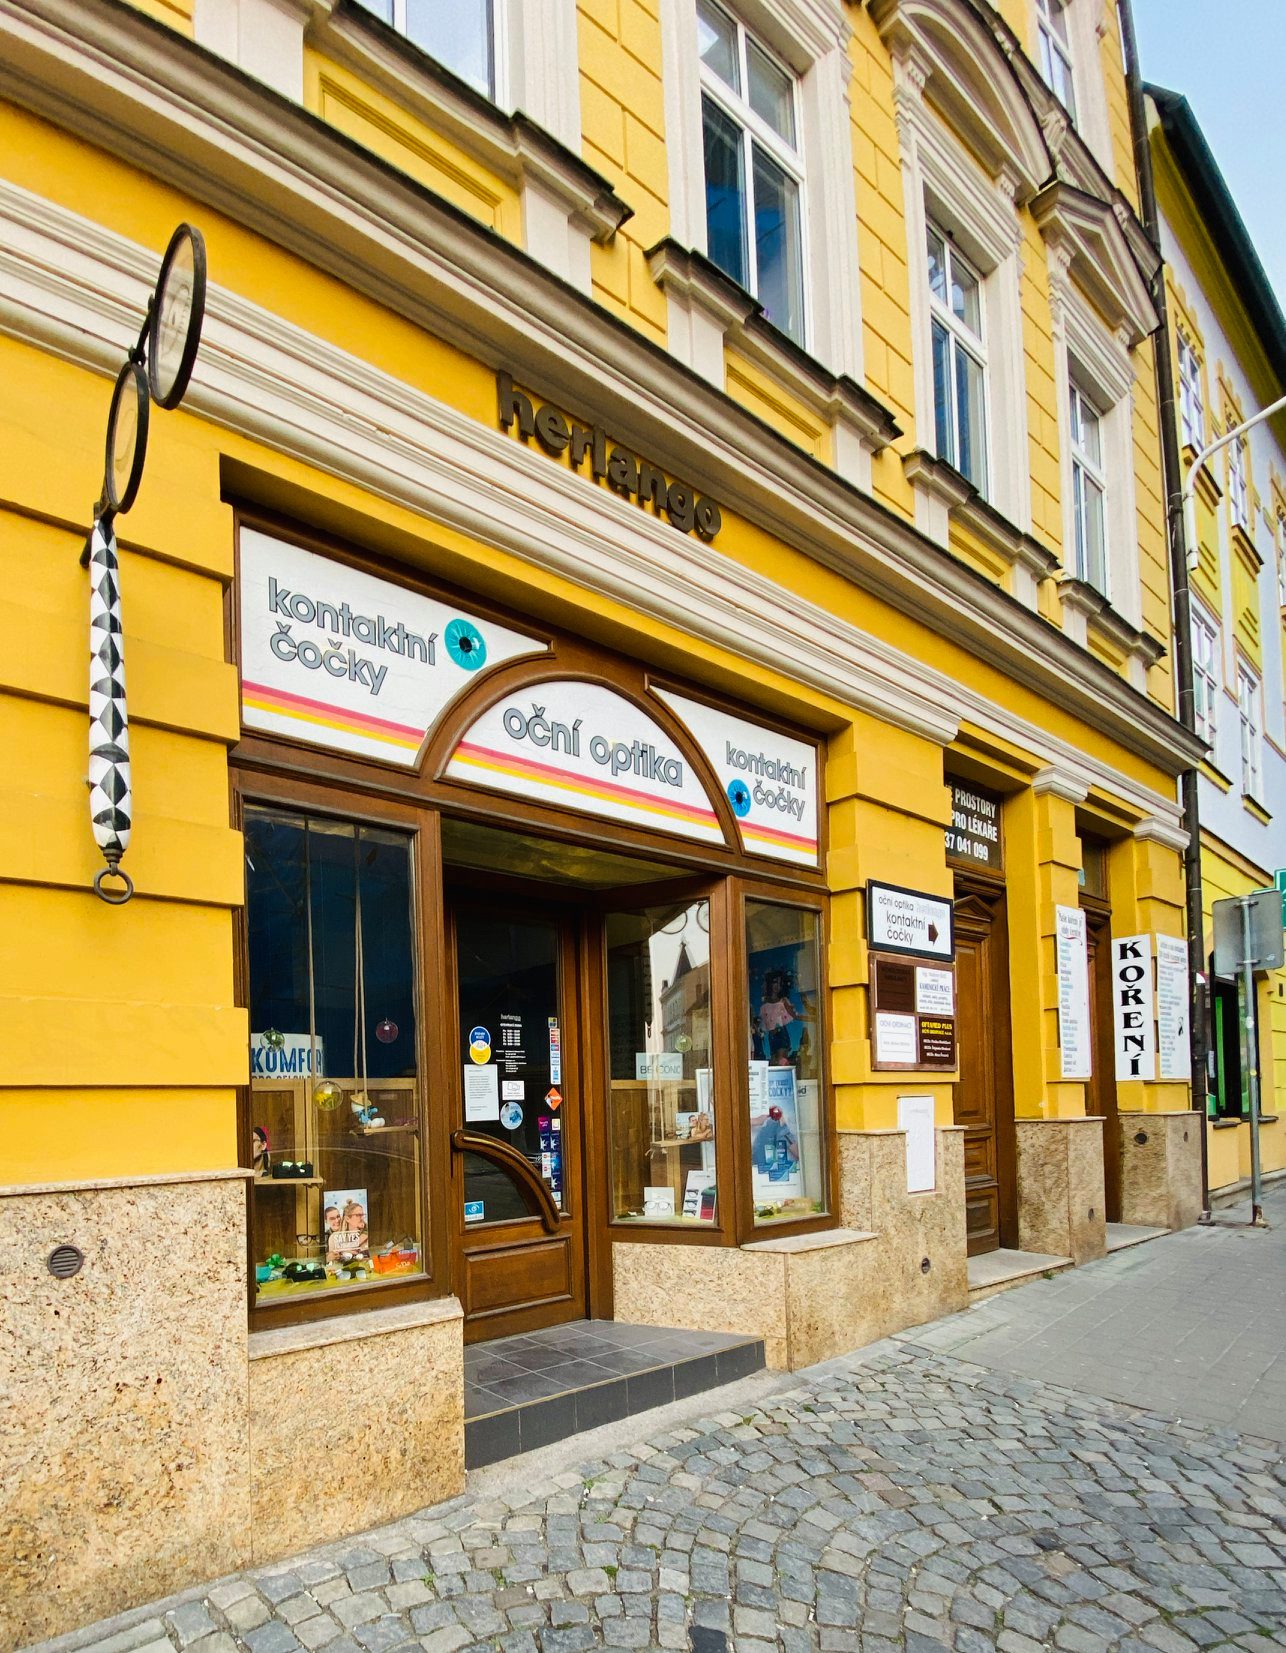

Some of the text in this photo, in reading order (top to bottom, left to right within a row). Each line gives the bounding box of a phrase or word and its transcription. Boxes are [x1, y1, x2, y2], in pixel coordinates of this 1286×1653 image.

[497, 369, 722, 542] herlango
[268, 576, 439, 666] kontaktní
[270, 620, 388, 695] čočky
[503, 702, 683, 787] oční optika
[725, 740, 807, 790] kontaktní
[752, 778, 806, 822] čočky
[955, 788, 996, 818] PROSTORY
[957, 835, 971, 855] 041
[973, 841, 989, 861] 099
[968, 814, 998, 842] LÉKAŘE
[879, 894, 893, 906] oční
[894, 899, 914, 911] optika
[886, 910, 926, 930] kontaktní
[886, 926, 914, 946] čočky
[1118, 940, 1146, 1076] KOŘENÍ
